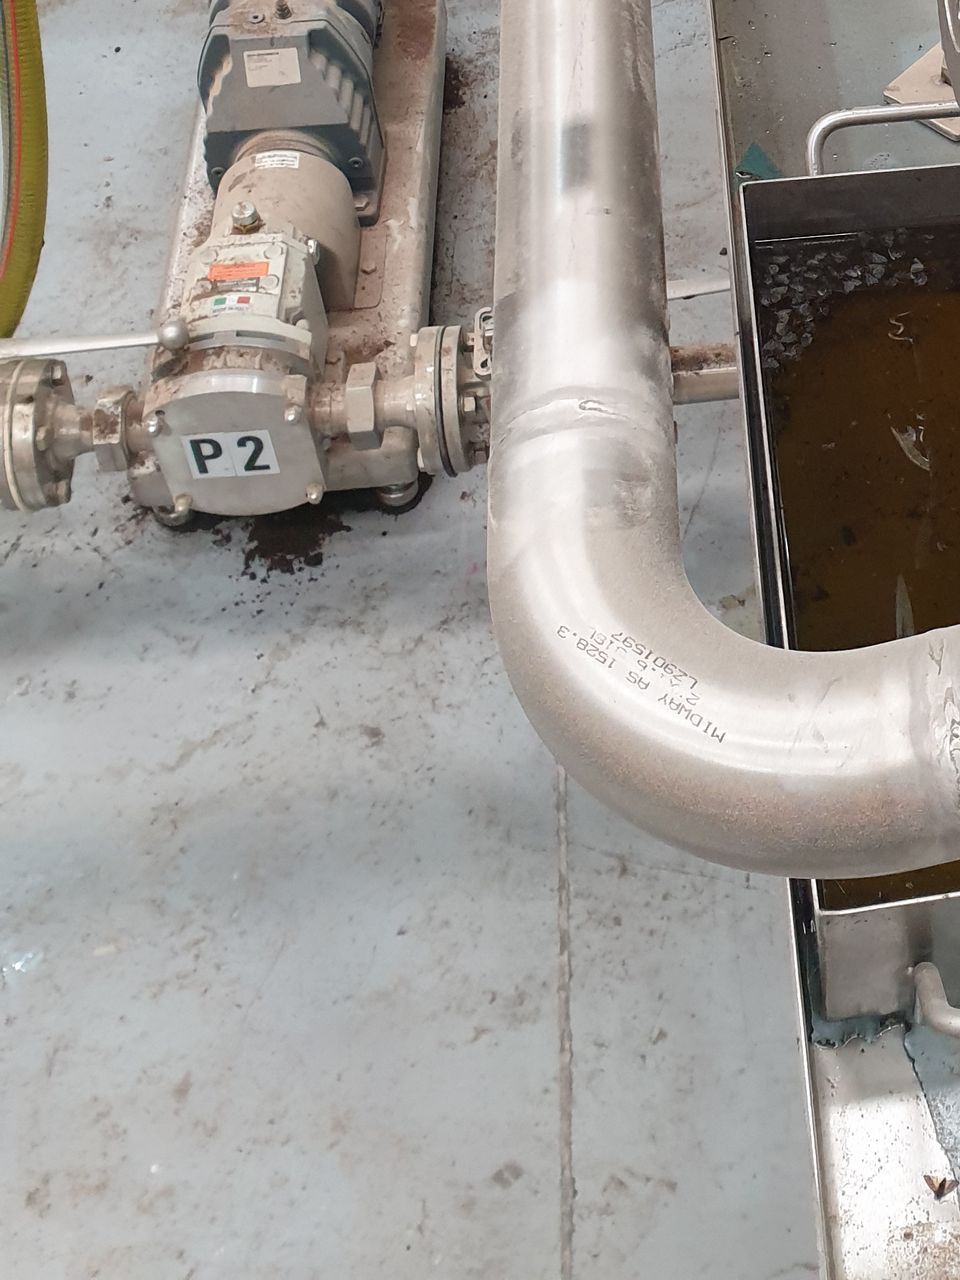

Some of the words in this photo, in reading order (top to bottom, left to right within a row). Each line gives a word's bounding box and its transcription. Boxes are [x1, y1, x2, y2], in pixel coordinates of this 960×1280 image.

[557, 625, 616, 669] 1528.3
[626, 671, 650, 690] AS
[657, 693, 726, 743] MIDWAY
